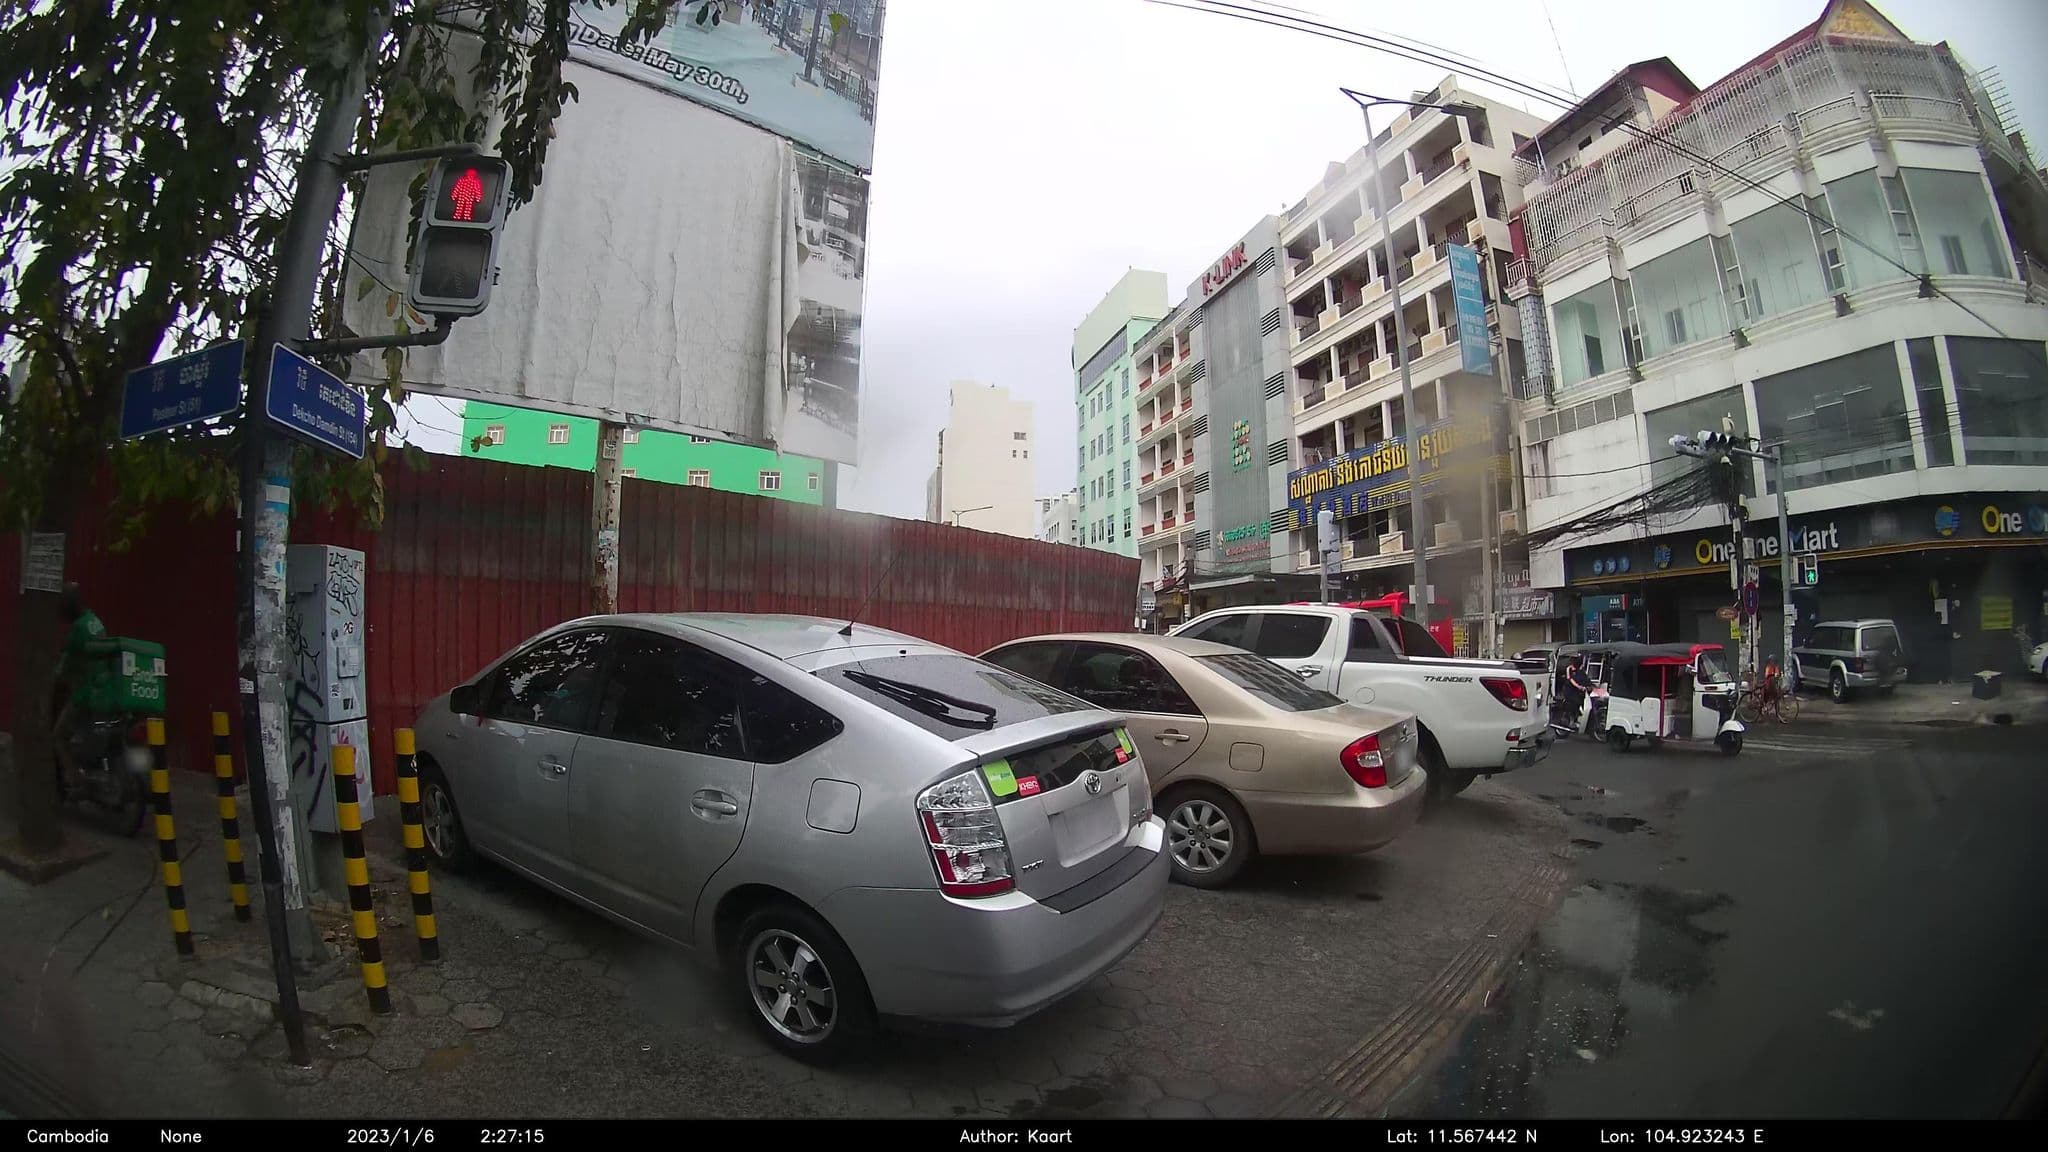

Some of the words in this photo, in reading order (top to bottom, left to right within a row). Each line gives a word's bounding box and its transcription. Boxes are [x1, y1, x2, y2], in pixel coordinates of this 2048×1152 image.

[581, 26, 641, 60] Date:
[648, 48, 692, 81] May
[693, 67, 749, 103] 30th,
[1981, 505, 2023, 533] One
[1695, 538, 1736, 565] One
[131, 682, 160, 699] Food
[1424, 675, 1473, 683] THUNDER
